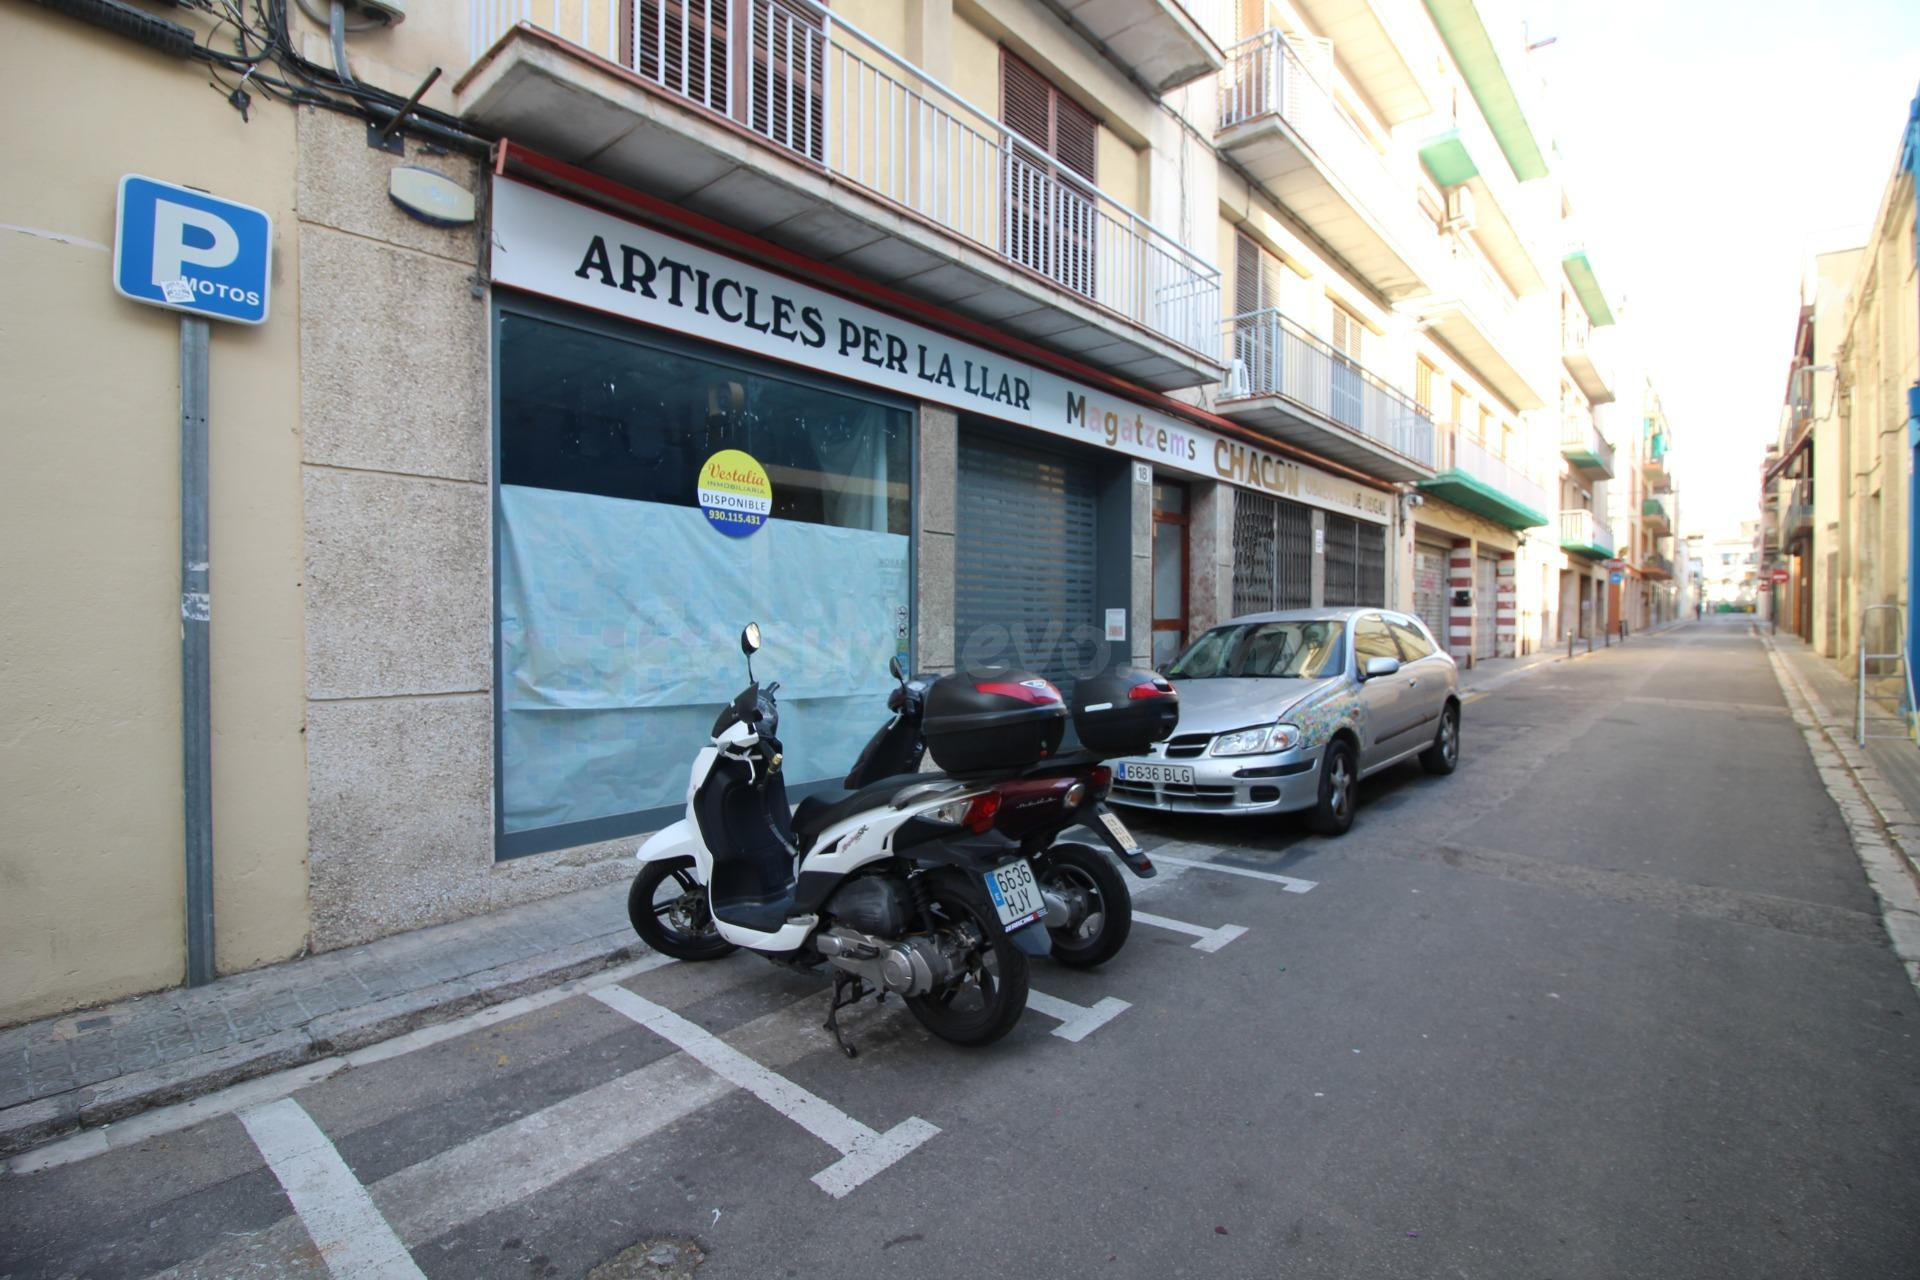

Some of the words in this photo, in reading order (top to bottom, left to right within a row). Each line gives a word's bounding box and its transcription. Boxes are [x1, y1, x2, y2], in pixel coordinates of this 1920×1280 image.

[152, 198, 240, 287] P
[181, 275, 260, 306] MOTOS
[574, 234, 826, 349] ARTICLES
[838, 317, 908, 374] PER
[917, 344, 956, 389] LA
[964, 360, 1030, 411] LLAR
[1066, 390, 1196, 461] Magatzems
[708, 463, 765, 487] Vestalia
[1138, 467, 1148, 481] 18
[706, 480, 766, 495] INMOBILIARIA
[702, 493, 766, 512] DISPONIBLE
[709, 509, 761, 526] 930.115.431
[1127, 765, 1160, 781] 6636
[1164, 768, 1190, 783] BLG
[997, 864, 1032, 893] 6636
[1005, 887, 1032, 917] HJY
